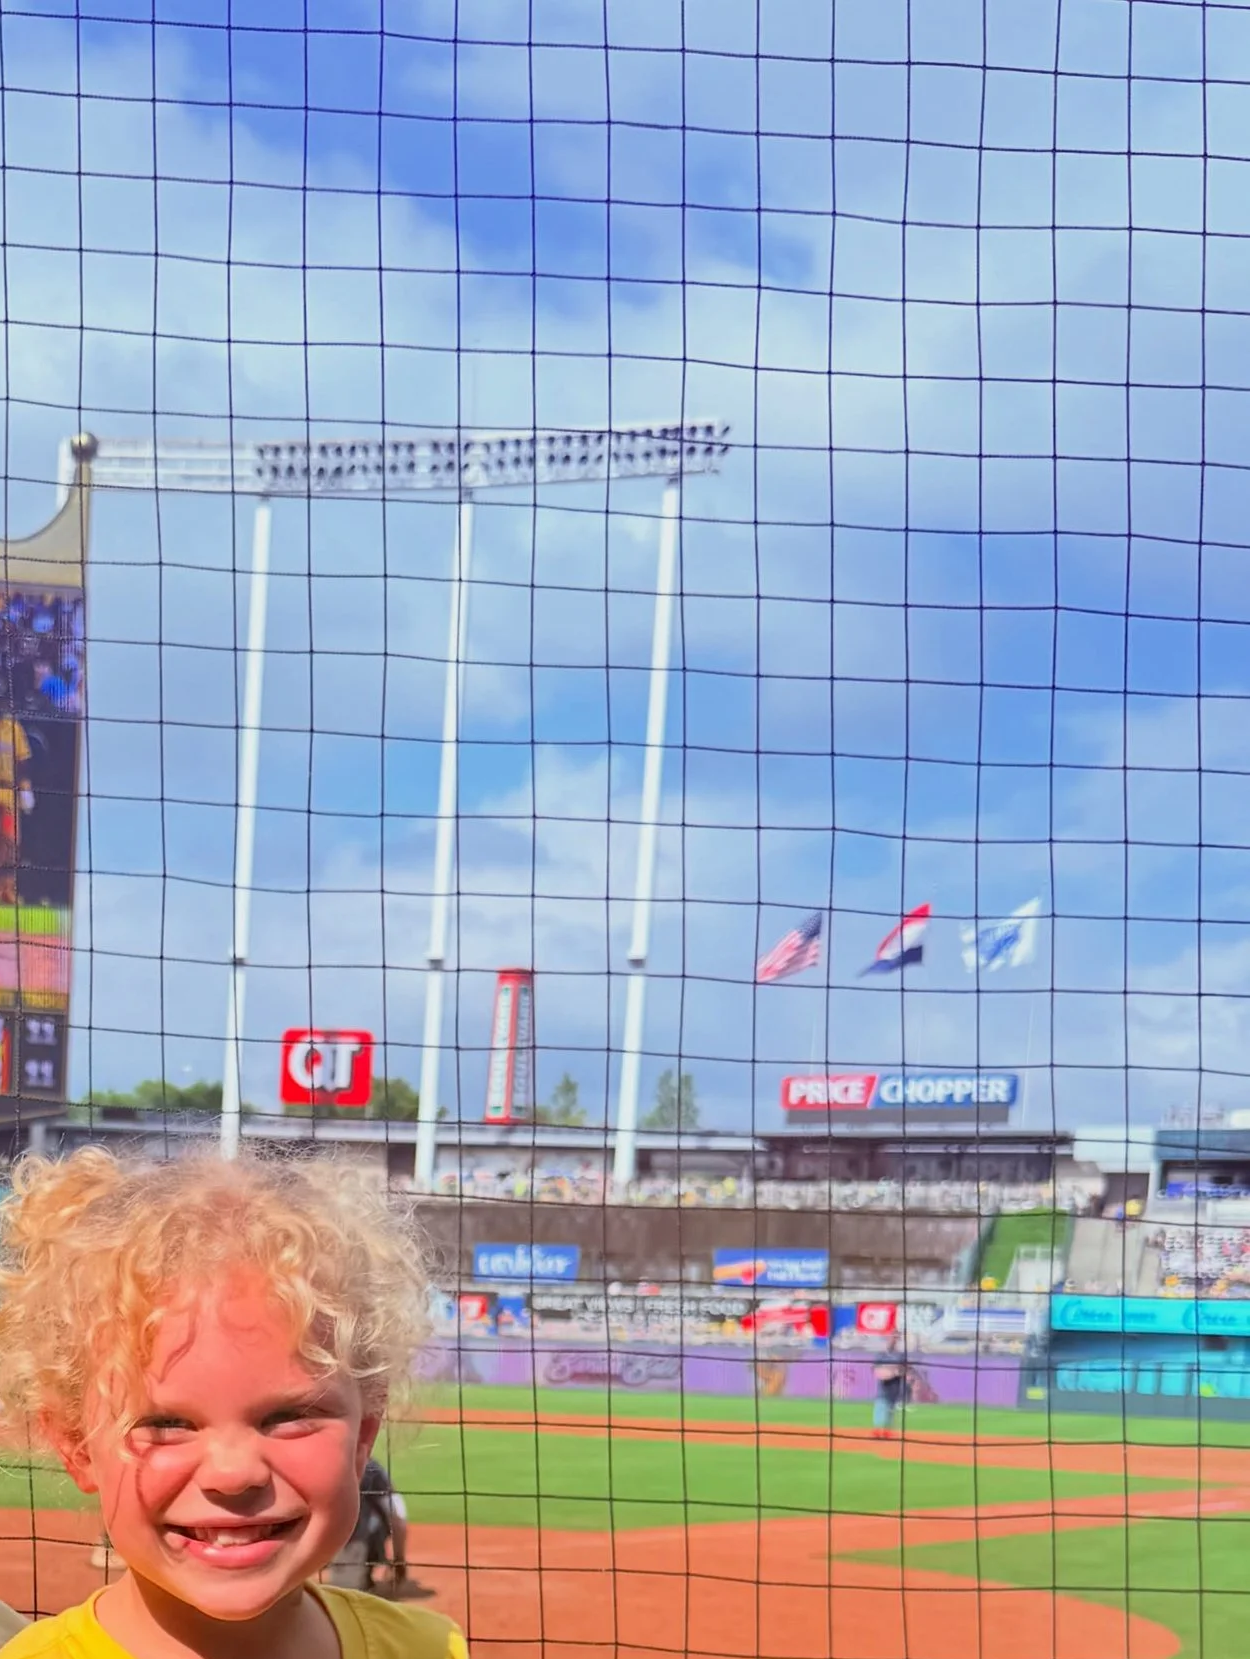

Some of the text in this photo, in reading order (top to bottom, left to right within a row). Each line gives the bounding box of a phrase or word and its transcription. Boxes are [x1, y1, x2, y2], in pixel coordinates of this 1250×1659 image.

[288, 1034, 361, 1091] QT
[788, 1074, 1010, 1104] PRICE CHOPPER
